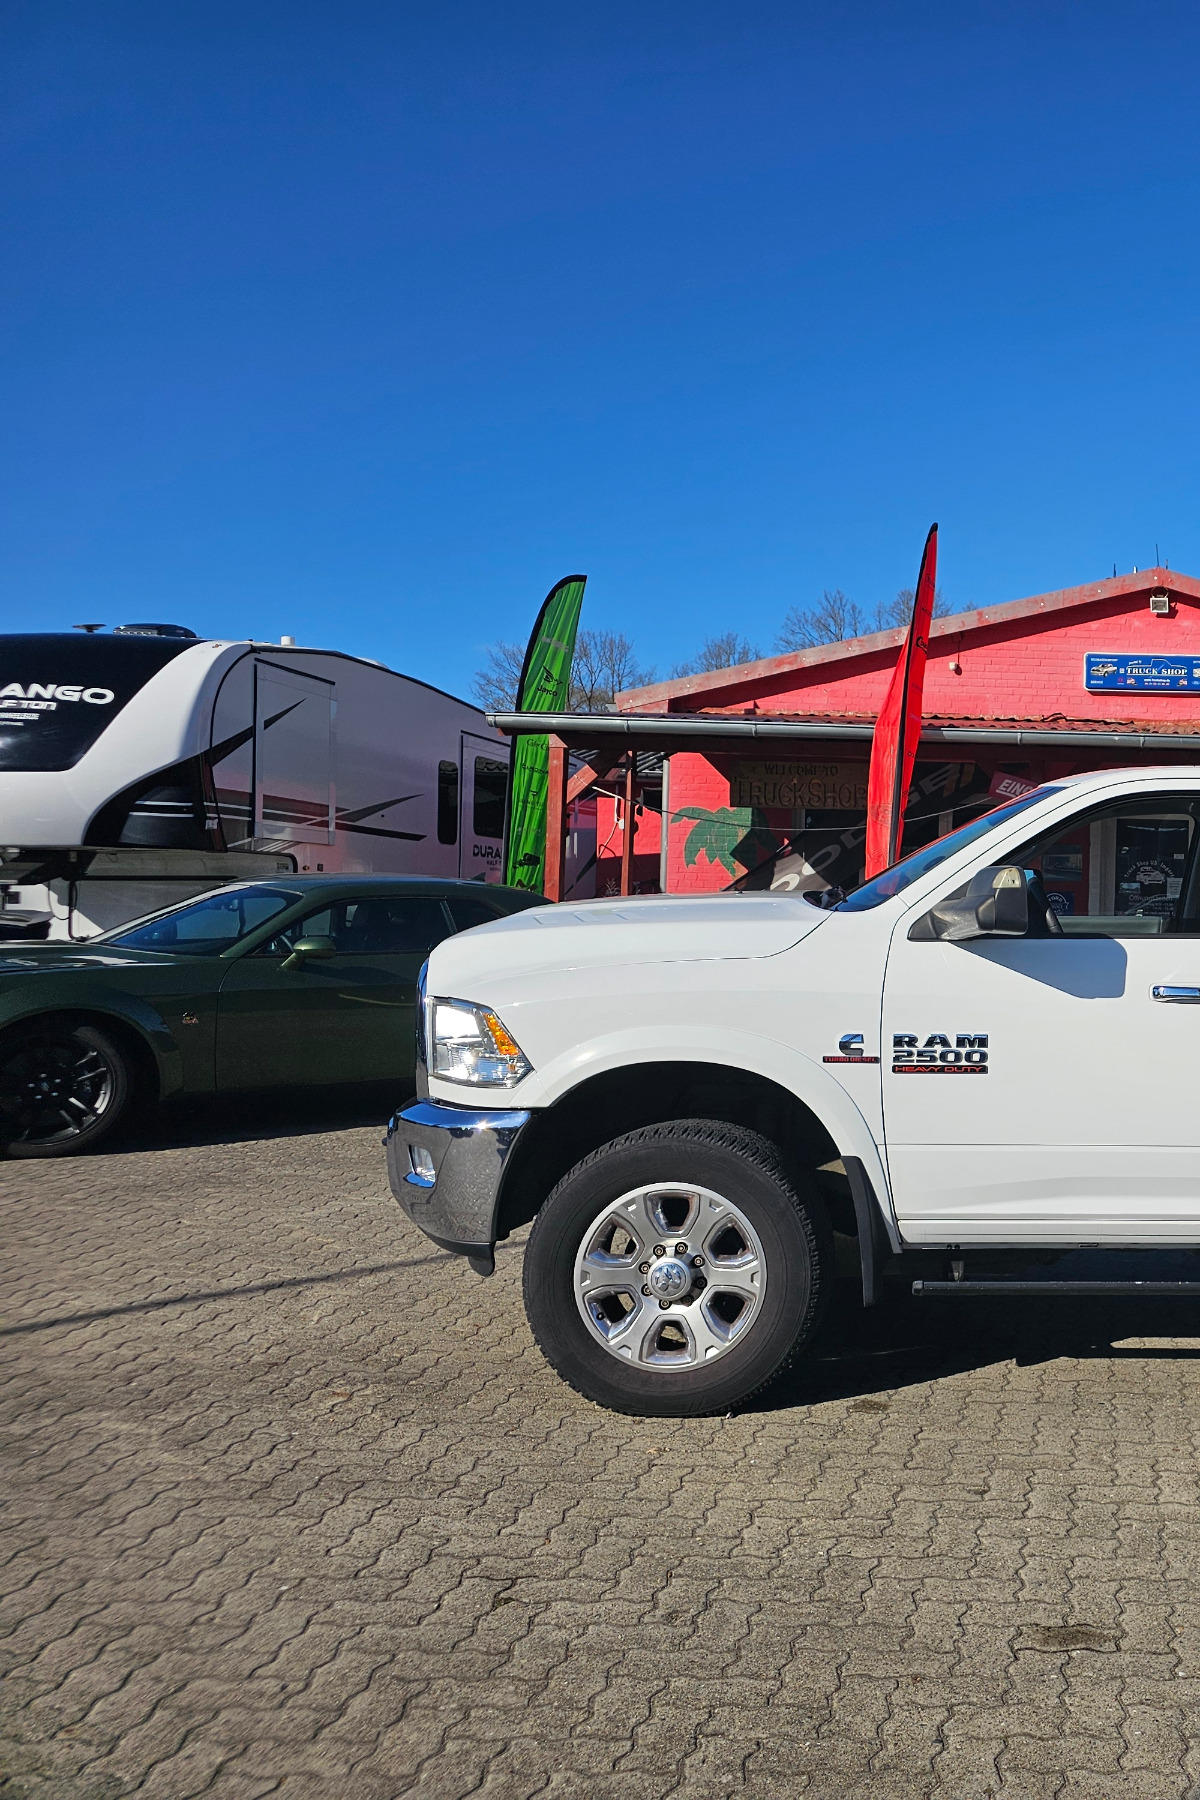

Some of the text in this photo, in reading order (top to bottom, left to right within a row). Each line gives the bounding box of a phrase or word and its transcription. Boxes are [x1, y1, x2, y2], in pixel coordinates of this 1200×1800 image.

[537, 685, 558, 697] Jayco
[472, 844, 503, 859] DURA
[892, 1033, 989, 1049] RAM
[892, 1049, 989, 1064] 2500
